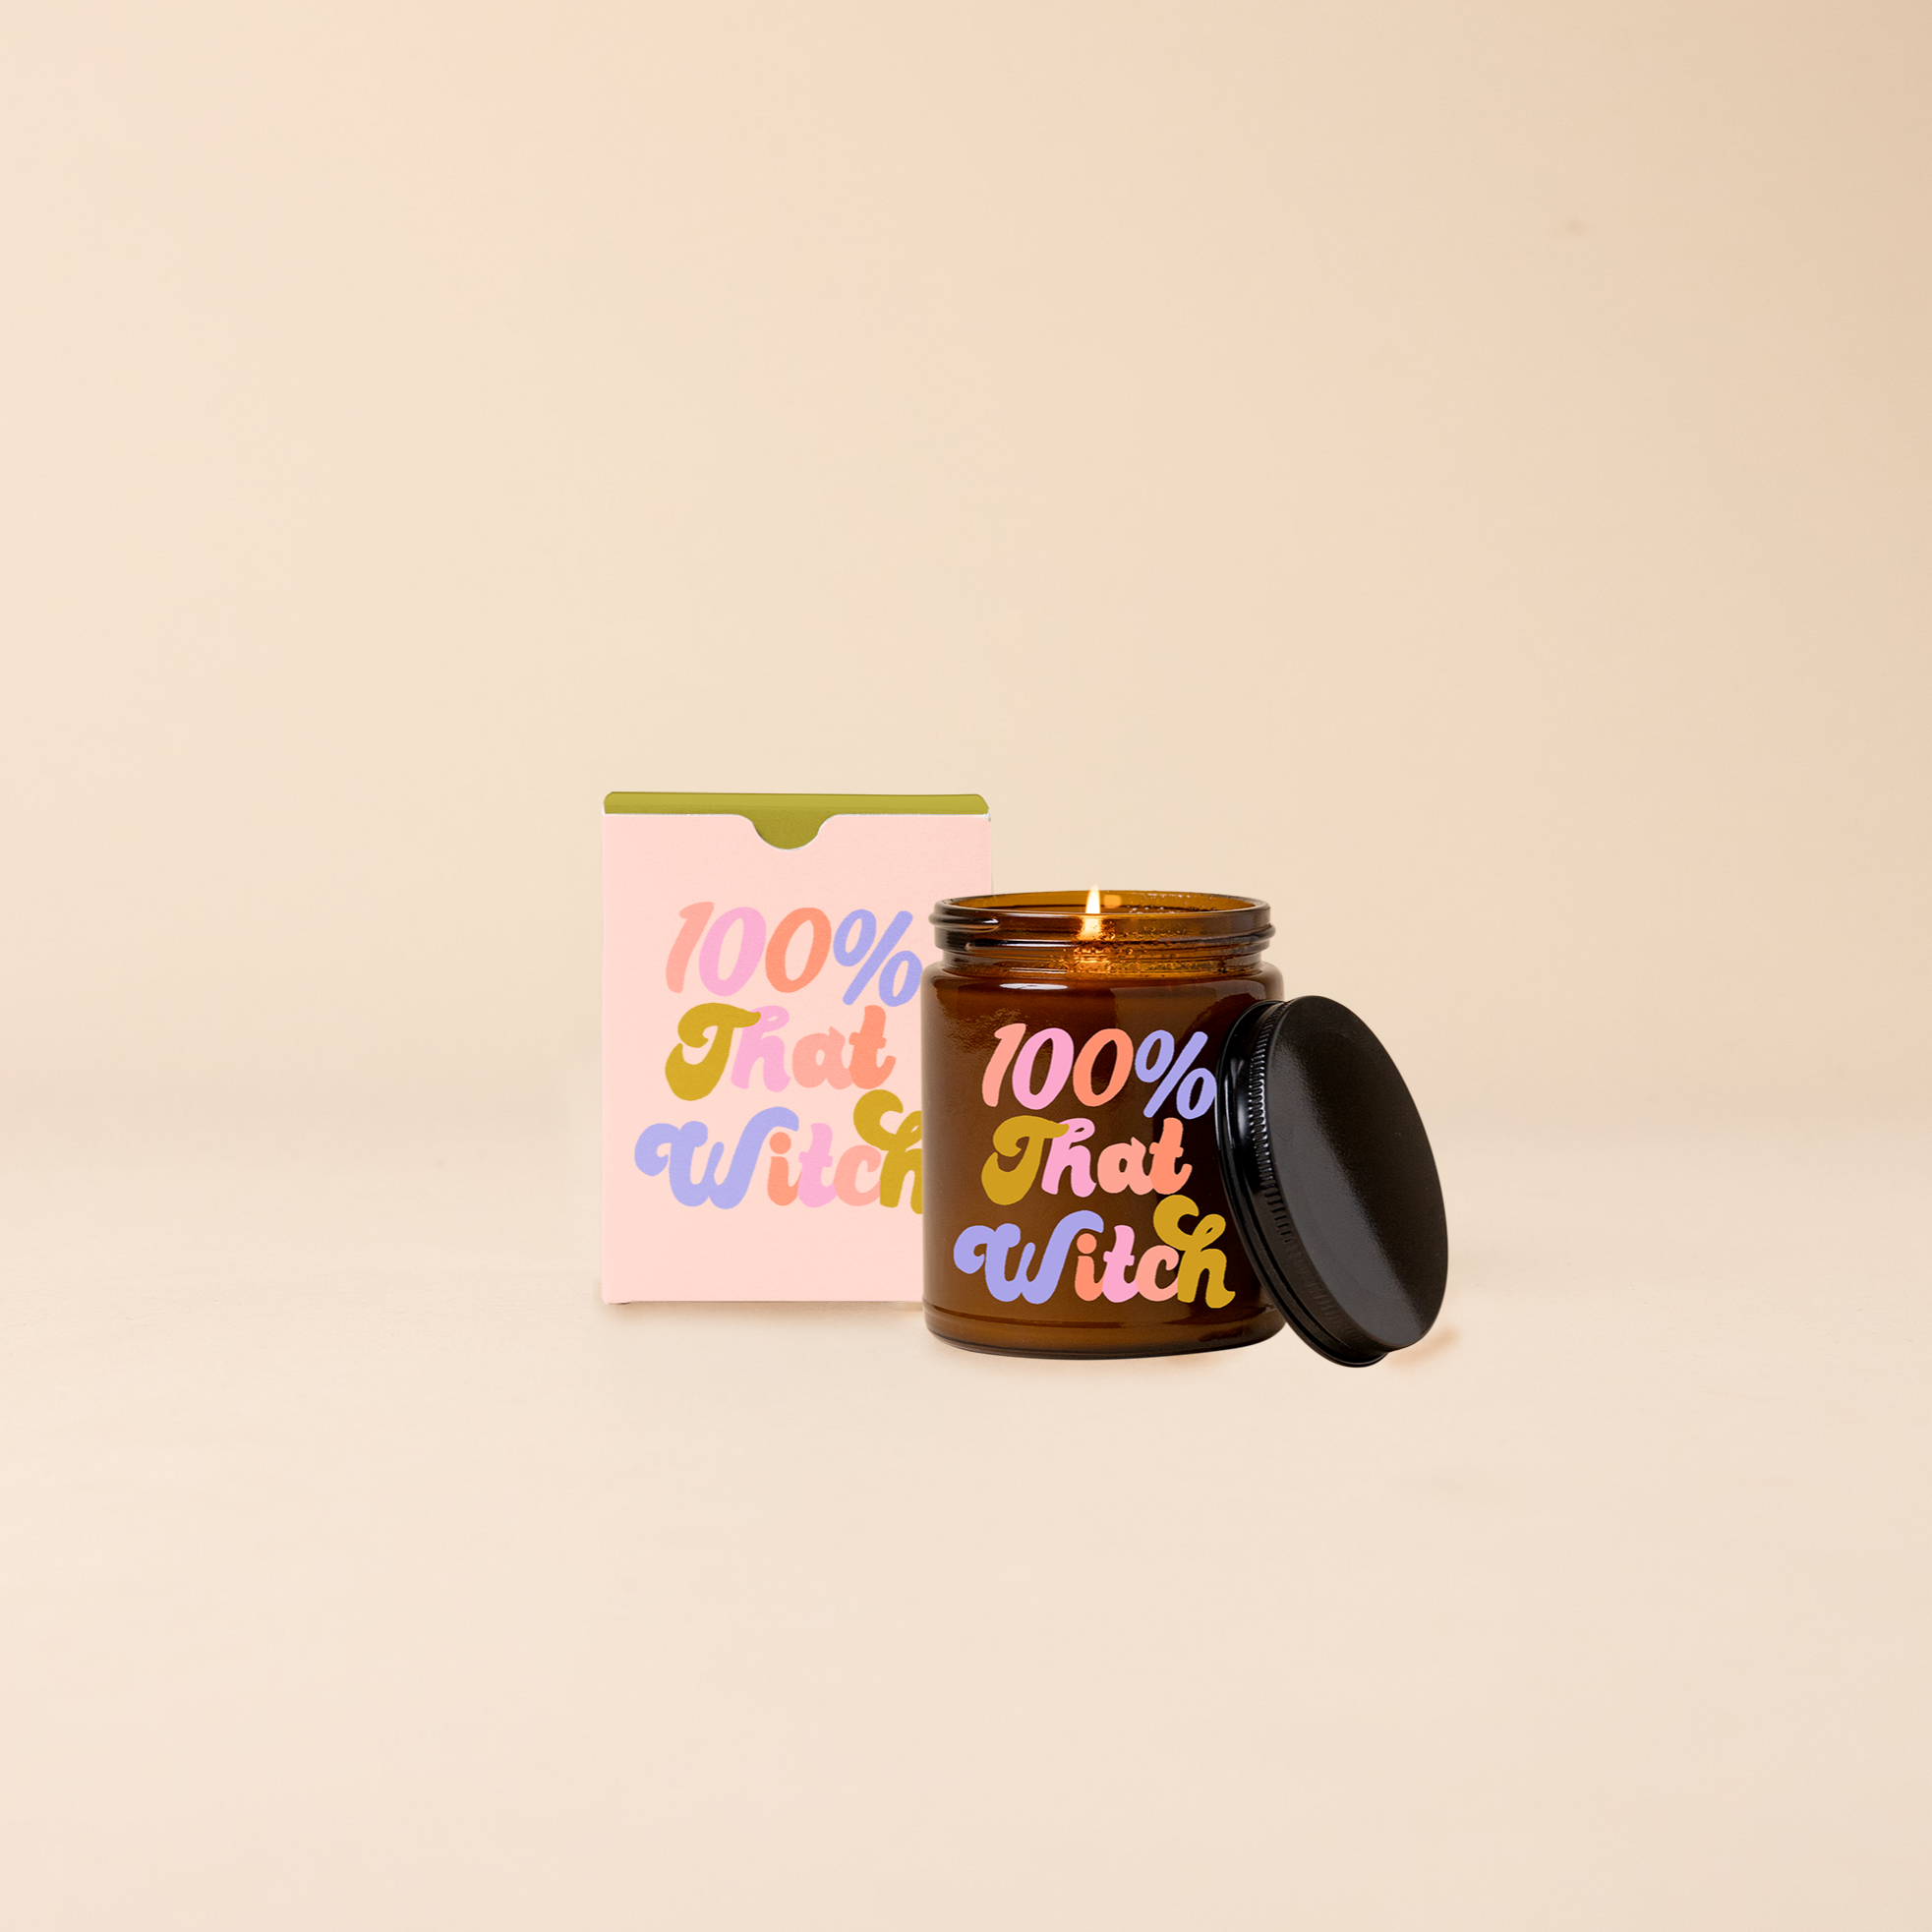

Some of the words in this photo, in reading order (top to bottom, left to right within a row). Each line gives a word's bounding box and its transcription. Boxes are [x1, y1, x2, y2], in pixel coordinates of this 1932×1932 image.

[666, 902, 922, 1007] 100%
[665, 1002, 896, 1101] That
[981, 1023, 1217, 1119] 100%
[634, 1089, 923, 1214] Witch
[981, 1115, 1192, 1205] That
[953, 1195, 1236, 1309] Witch
